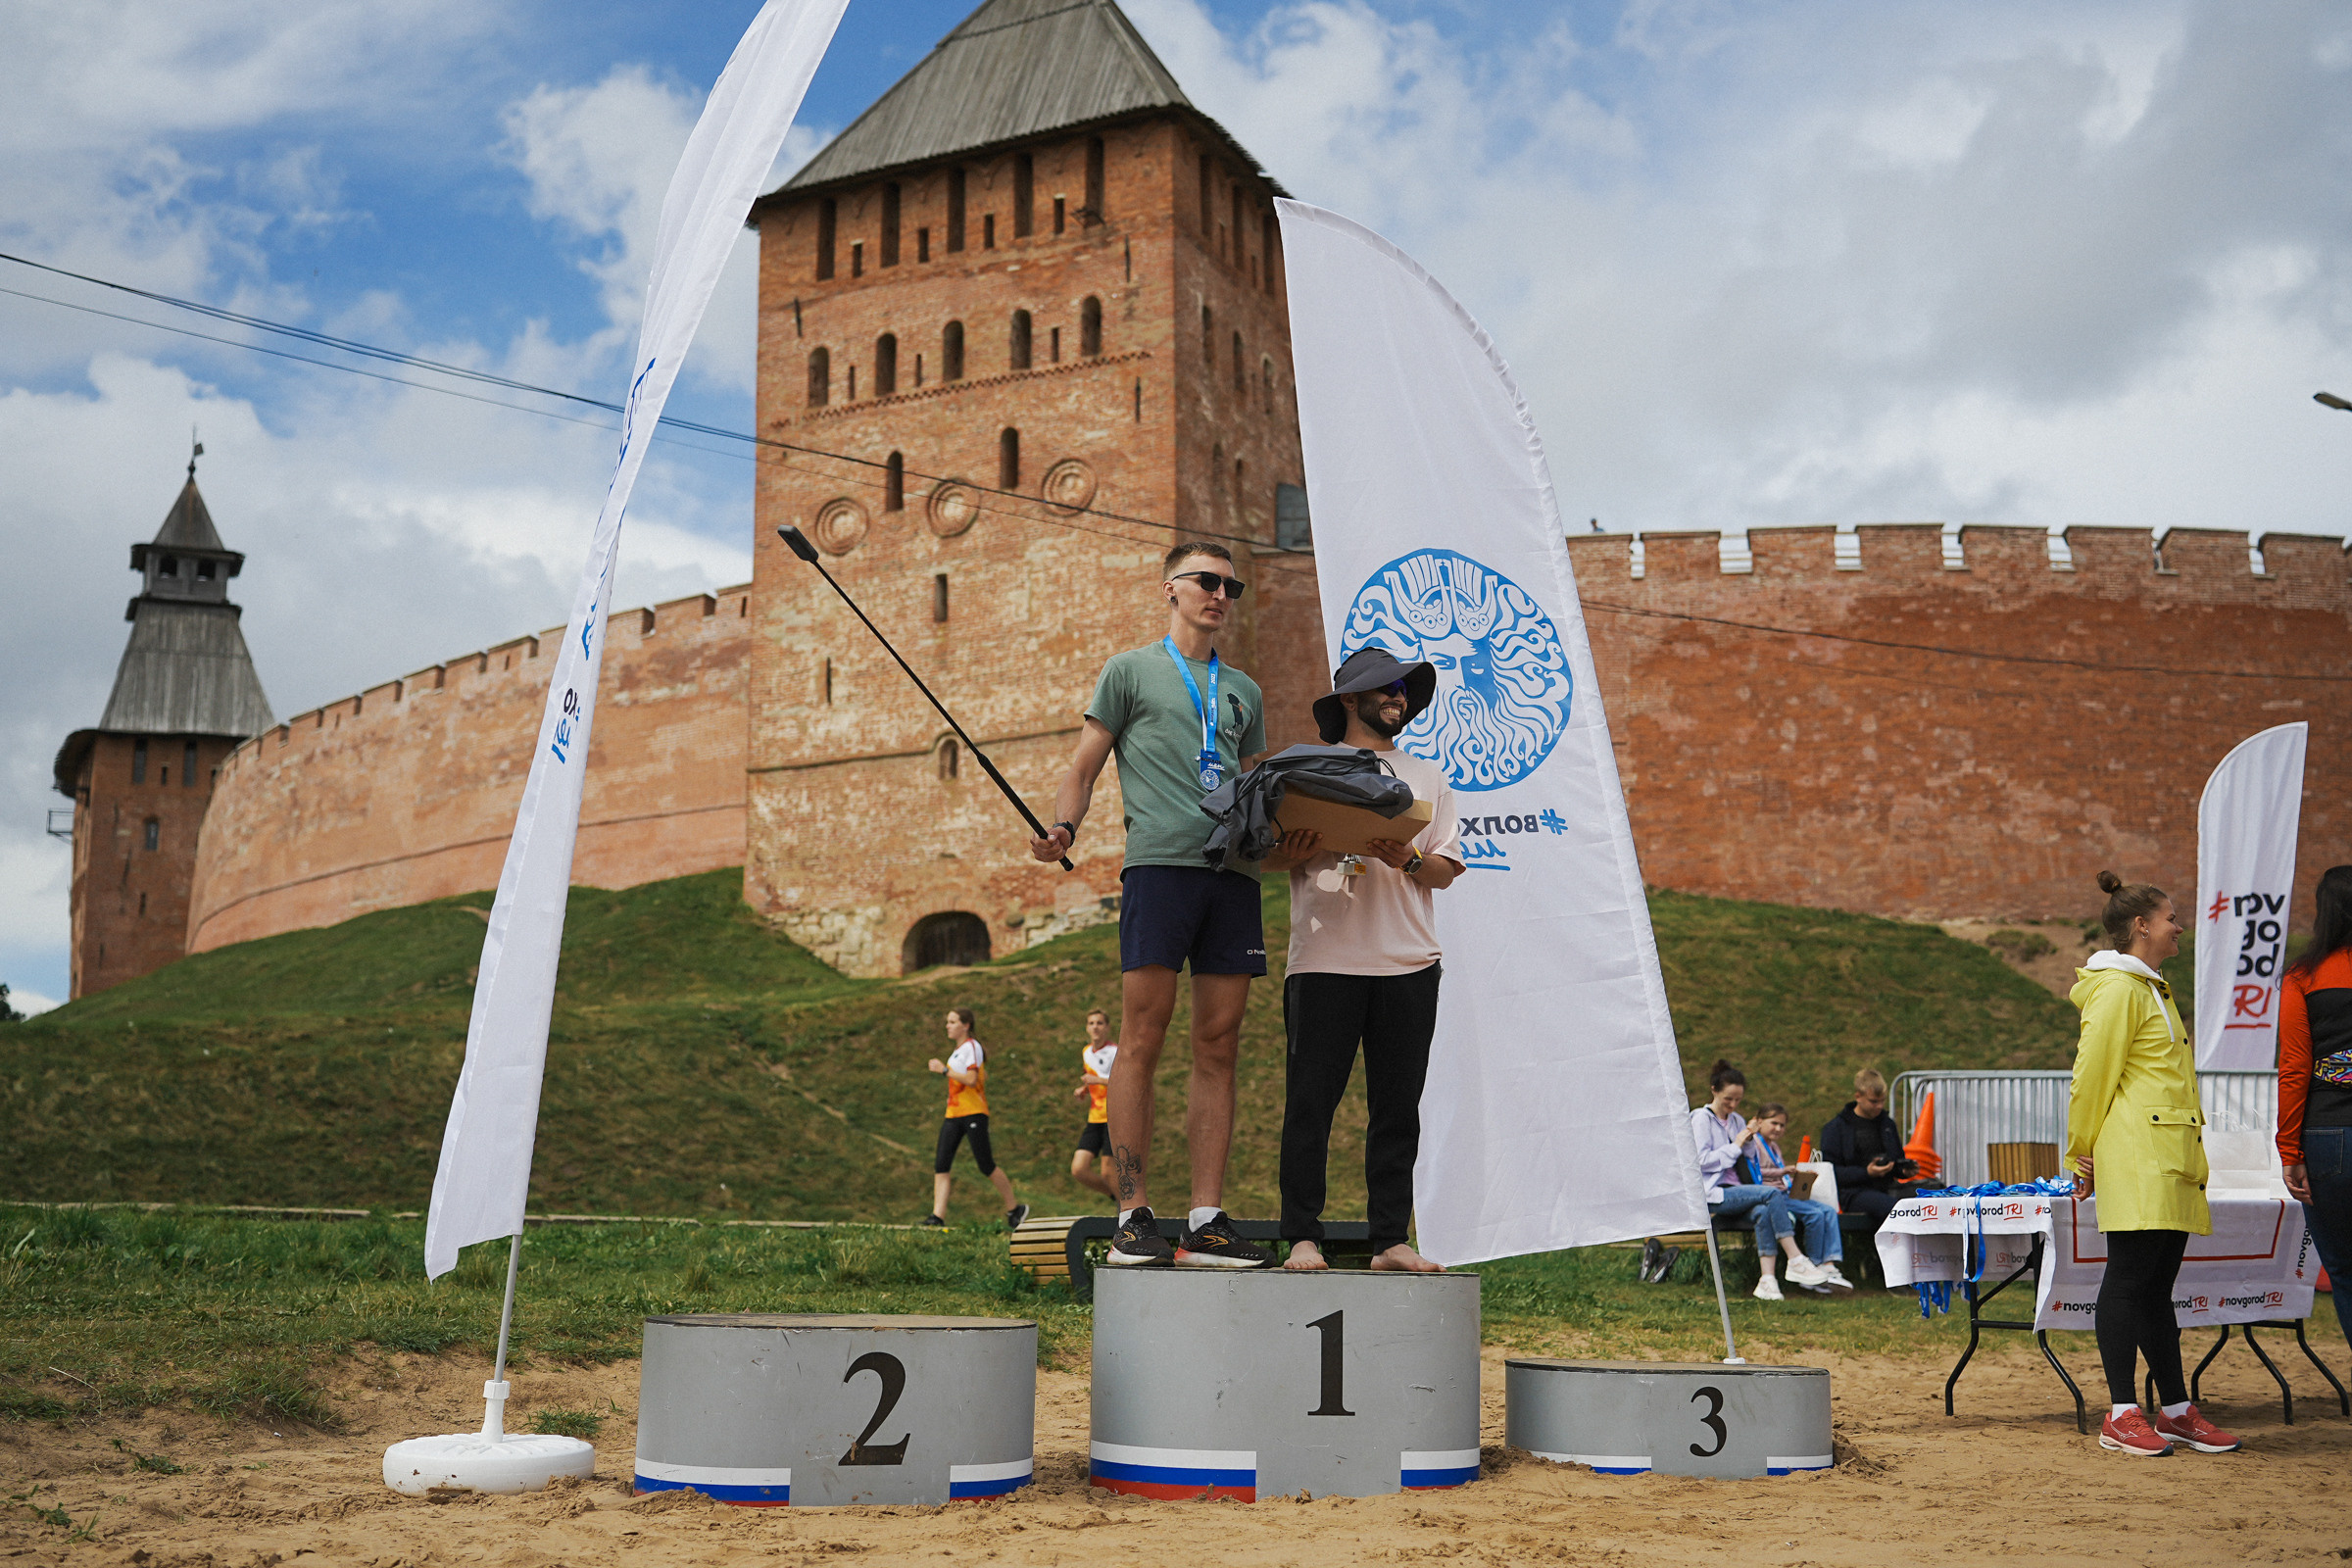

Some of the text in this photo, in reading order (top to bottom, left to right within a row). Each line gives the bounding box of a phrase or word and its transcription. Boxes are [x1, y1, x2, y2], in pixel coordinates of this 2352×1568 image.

[2218, 1292, 2283, 1308] #novgorodTRI
[1305, 1309, 1355, 1416] 1
[838, 1351, 911, 1466] 2
[1690, 1386, 1727, 1457] 3
